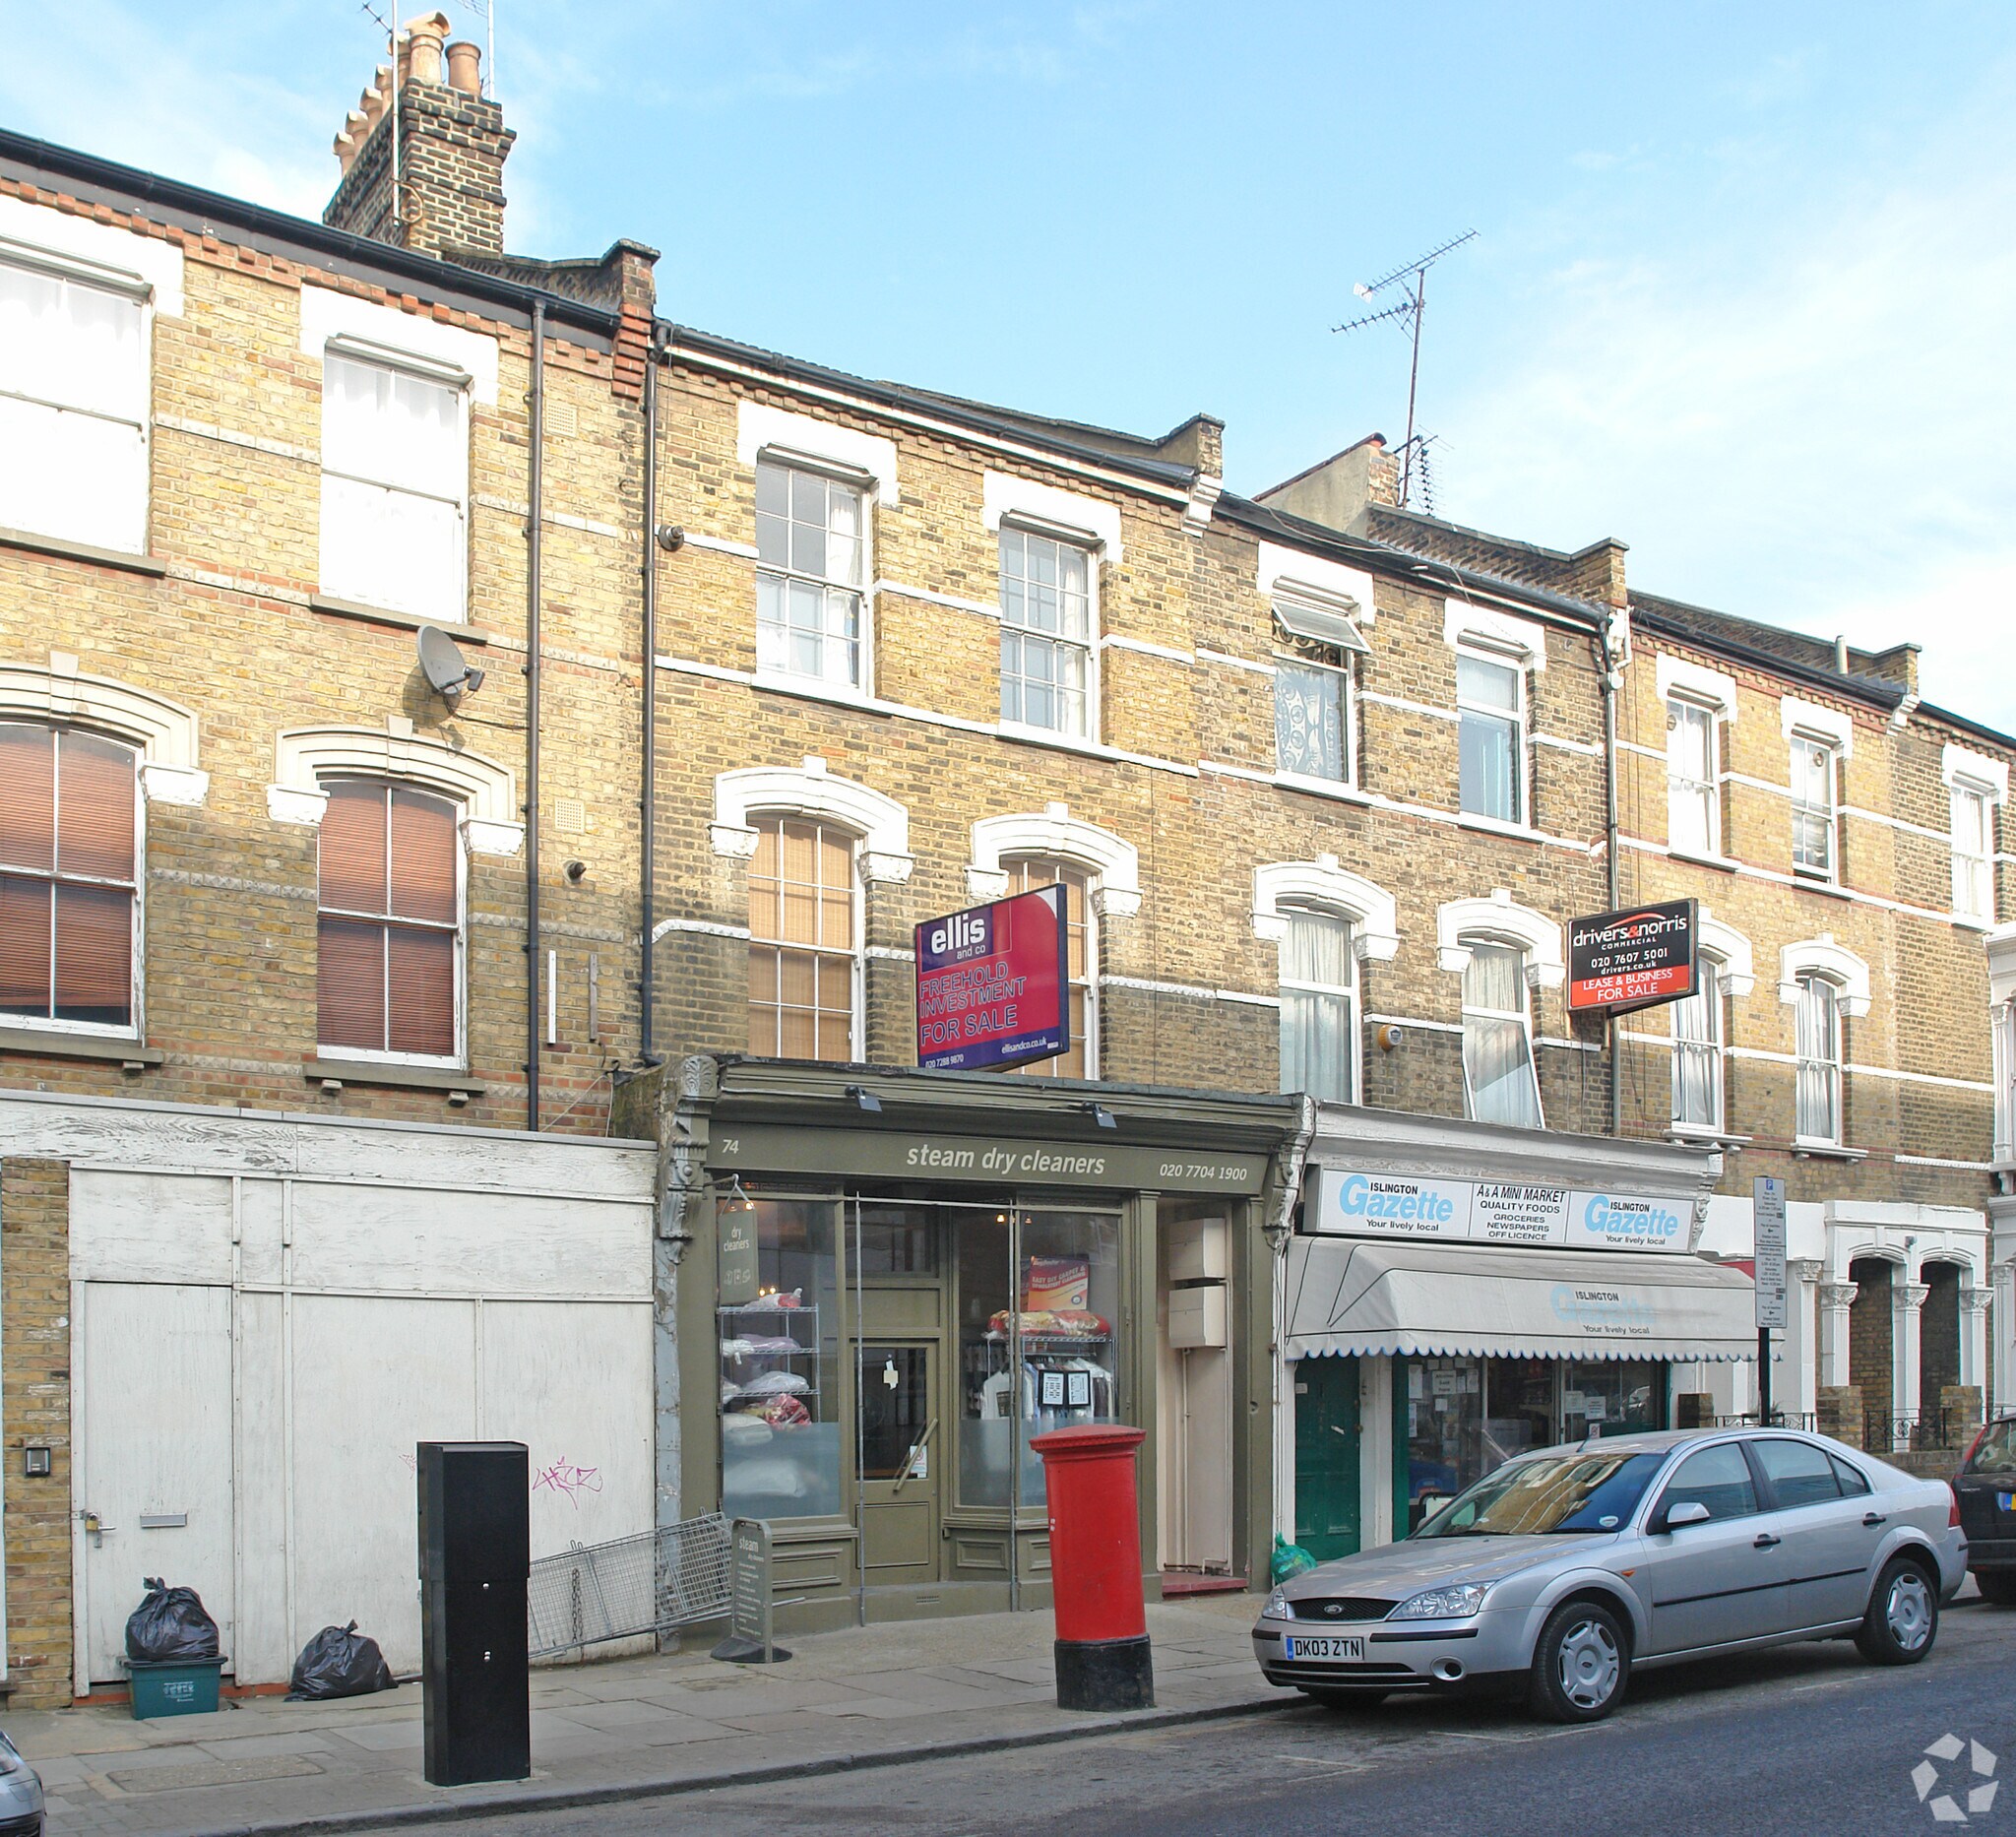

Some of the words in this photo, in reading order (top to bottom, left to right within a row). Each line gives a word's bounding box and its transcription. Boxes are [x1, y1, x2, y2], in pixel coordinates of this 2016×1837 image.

[931, 914, 985, 954] ellis
[1573, 915, 1687, 947] drivers&norris
[1602, 936, 1657, 951] COMMERCIAL
[957, 945, 973, 960] and
[975, 944, 986, 955] co
[1591, 956, 1610, 969] 020
[1614, 952, 1639, 965] 7607
[1644, 947, 1668, 960] 5001
[1601, 960, 1657, 976] drivers.co.uk
[919, 961, 1008, 999] FREEHOLD
[1583, 976, 1613, 990] LEASE
[1615, 976, 1623, 985] &
[1625, 969, 1672, 984] BUSINESS
[919, 977, 1027, 1018] INVESTMENT
[1597, 987, 1623, 1002] FOR
[1627, 982, 1658, 997] SALE
[920, 1018, 960, 1046] FOR
[965, 1005, 1018, 1037] SALE
[1001, 1036, 1046, 1054] ellisandco.co.uk
[722, 1139, 739, 1154] 74
[907, 1144, 975, 1168] steam
[981, 1147, 1016, 1174] dry
[1020, 1150, 1105, 1175] cleaners
[1159, 1163, 1183, 1177] 020
[1185, 1165, 1215, 1179] 7704
[1218, 1167, 1247, 1181] 1900
[1370, 1181, 1418, 1195] ISLINGTON
[1501, 1186, 1522, 1200] MINI
[1524, 1187, 1566, 1203] MARKET
[1339, 1174, 1453, 1222] Gazette
[1480, 1200, 1524, 1211] QUALITY
[1526, 1204, 1560, 1214] FOODS
[1584, 1194, 1678, 1236] Gazette
[1609, 1201, 1651, 1213] ISLINGTON
[1366, 1219, 1387, 1229] Your
[1390, 1221, 1415, 1232] lively
[1417, 1222, 1439, 1232] local
[1493, 1213, 1545, 1224] GROCERIES
[730, 1225, 742, 1240] dry
[1486, 1222, 1549, 1233] NEWSPAPERS
[1508, 1232, 1547, 1240] LICENCE
[1606, 1235, 1623, 1243] Your
[1625, 1235, 1645, 1246] lively
[723, 1239, 750, 1252] cleaners
[1575, 1291, 1619, 1301] ISLINGTON
[1583, 1324, 1603, 1334] Your
[1604, 1325, 1627, 1336] lively
[1629, 1326, 1651, 1335] local
[738, 1536, 759, 1552] steam
[1294, 1639, 1329, 1657] DK03
[1333, 1639, 1360, 1657] ZTN
